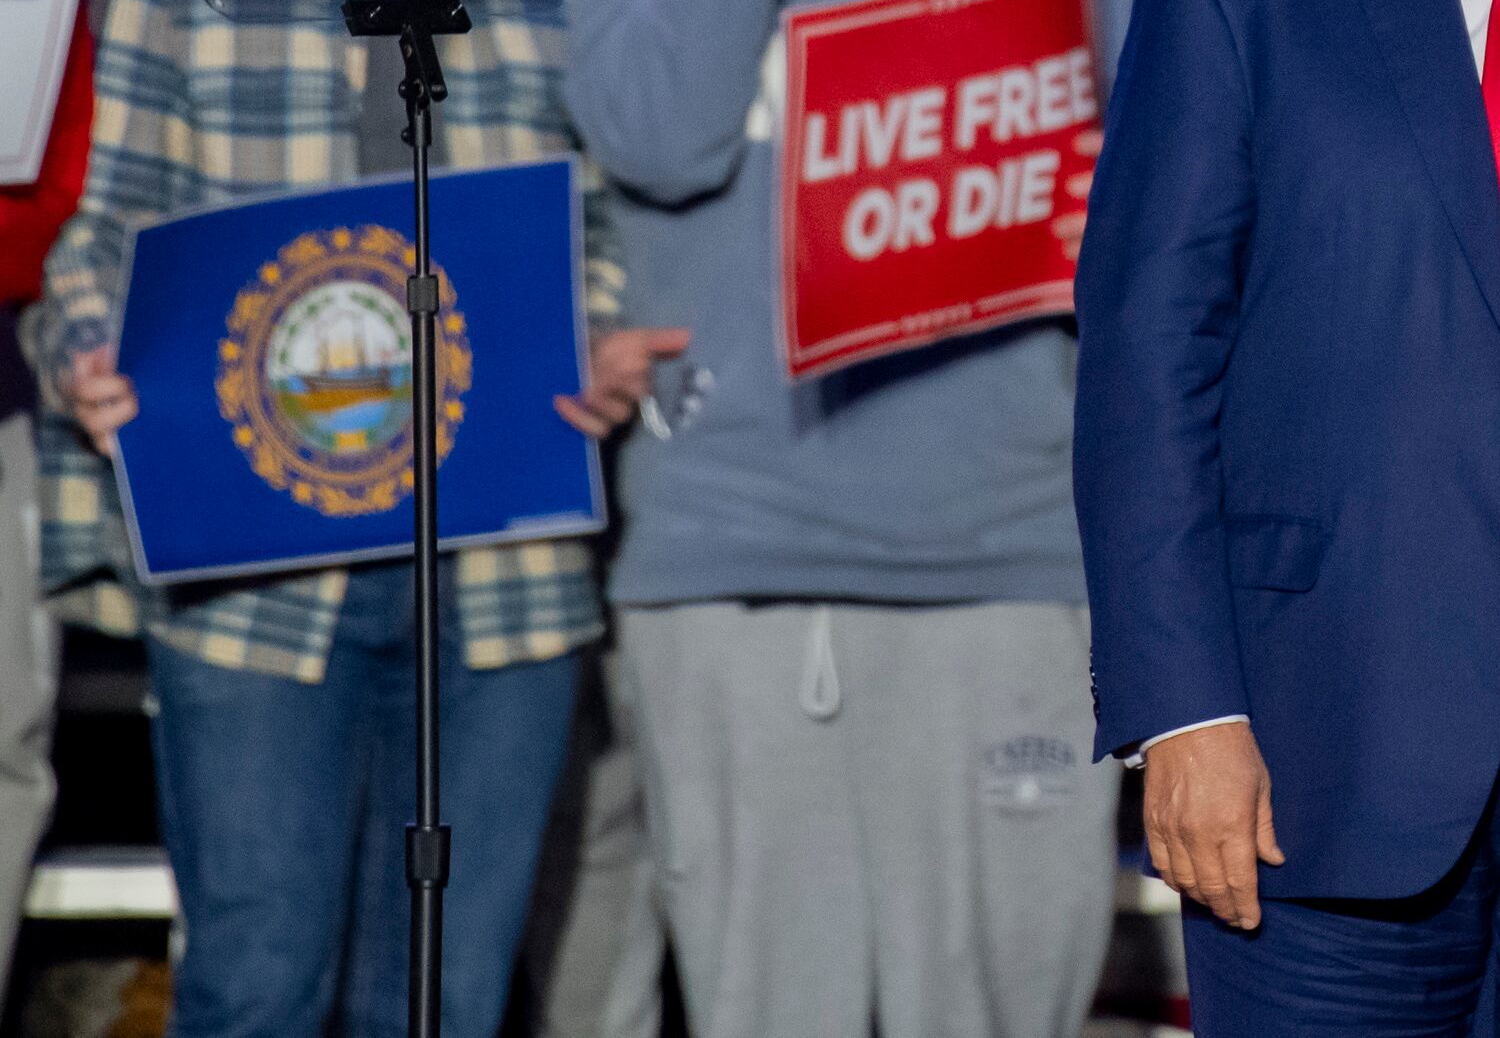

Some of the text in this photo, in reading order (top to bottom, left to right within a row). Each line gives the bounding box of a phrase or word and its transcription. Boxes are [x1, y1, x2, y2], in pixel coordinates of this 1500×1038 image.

[801, 47, 1098, 183] LIVE FREE
[842, 149, 1061, 261] OR DIE
